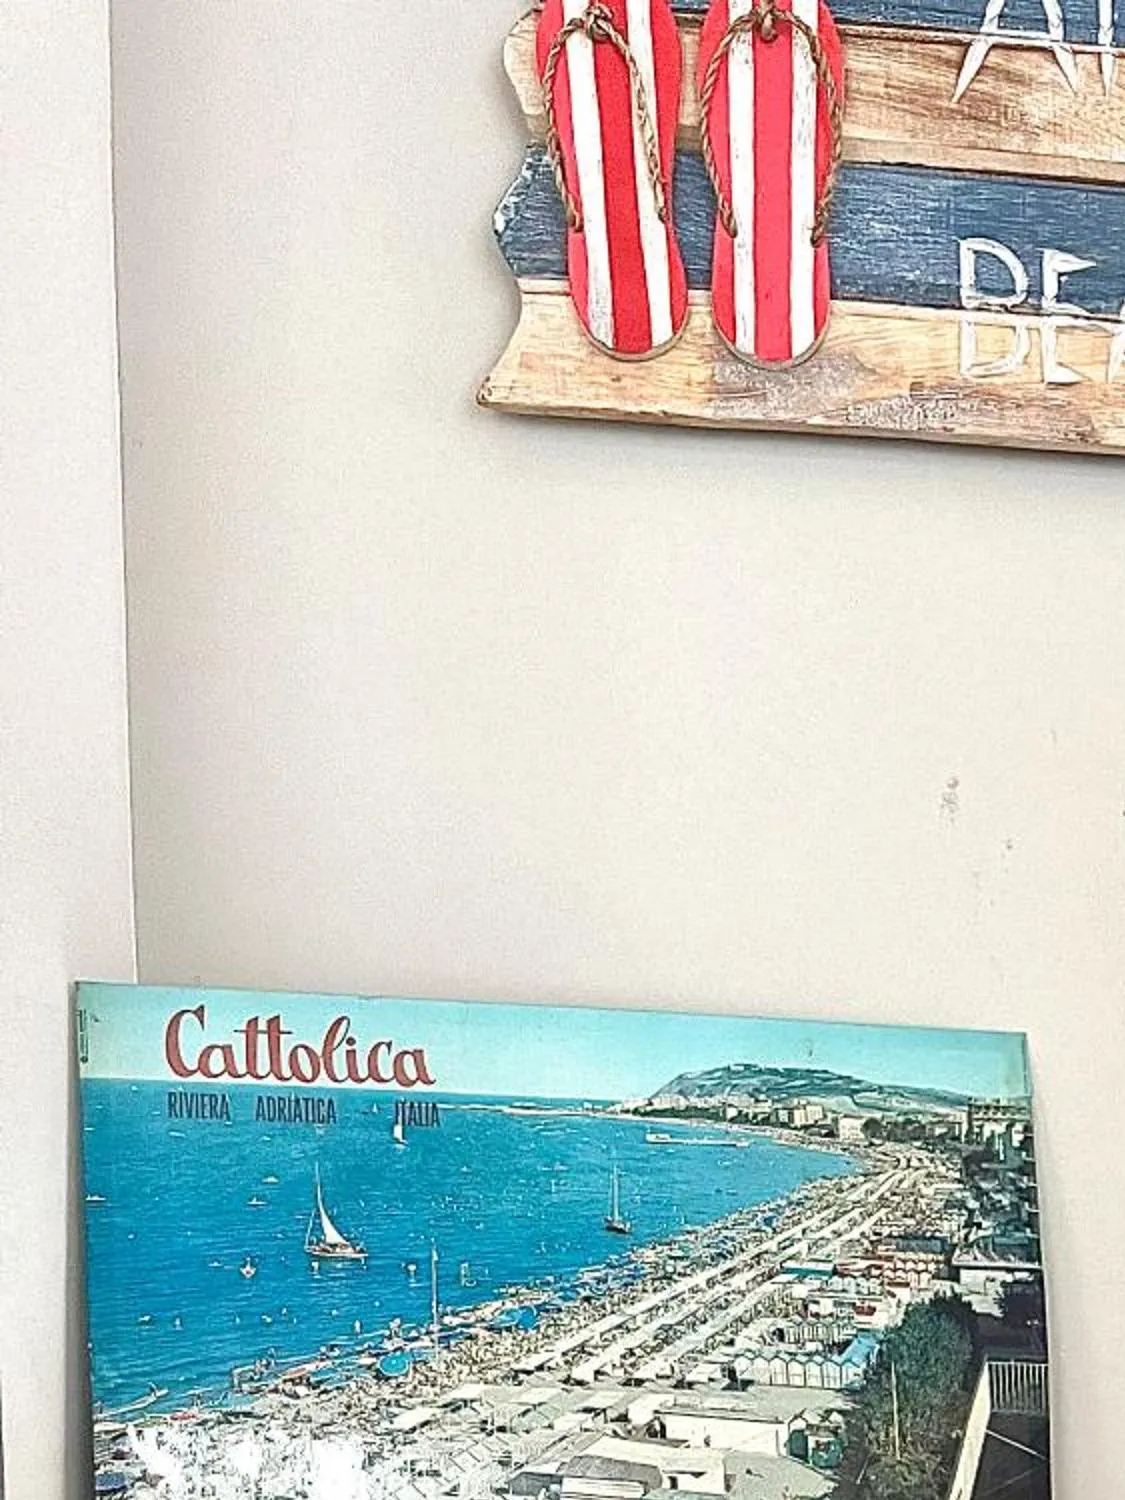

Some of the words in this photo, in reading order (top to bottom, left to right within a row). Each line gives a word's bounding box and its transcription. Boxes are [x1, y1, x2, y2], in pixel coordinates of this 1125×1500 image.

[164, 1004, 437, 1088] Cattolica
[167, 1091, 231, 1121] RIVIERA
[255, 1095, 338, 1125] ADRIATICA
